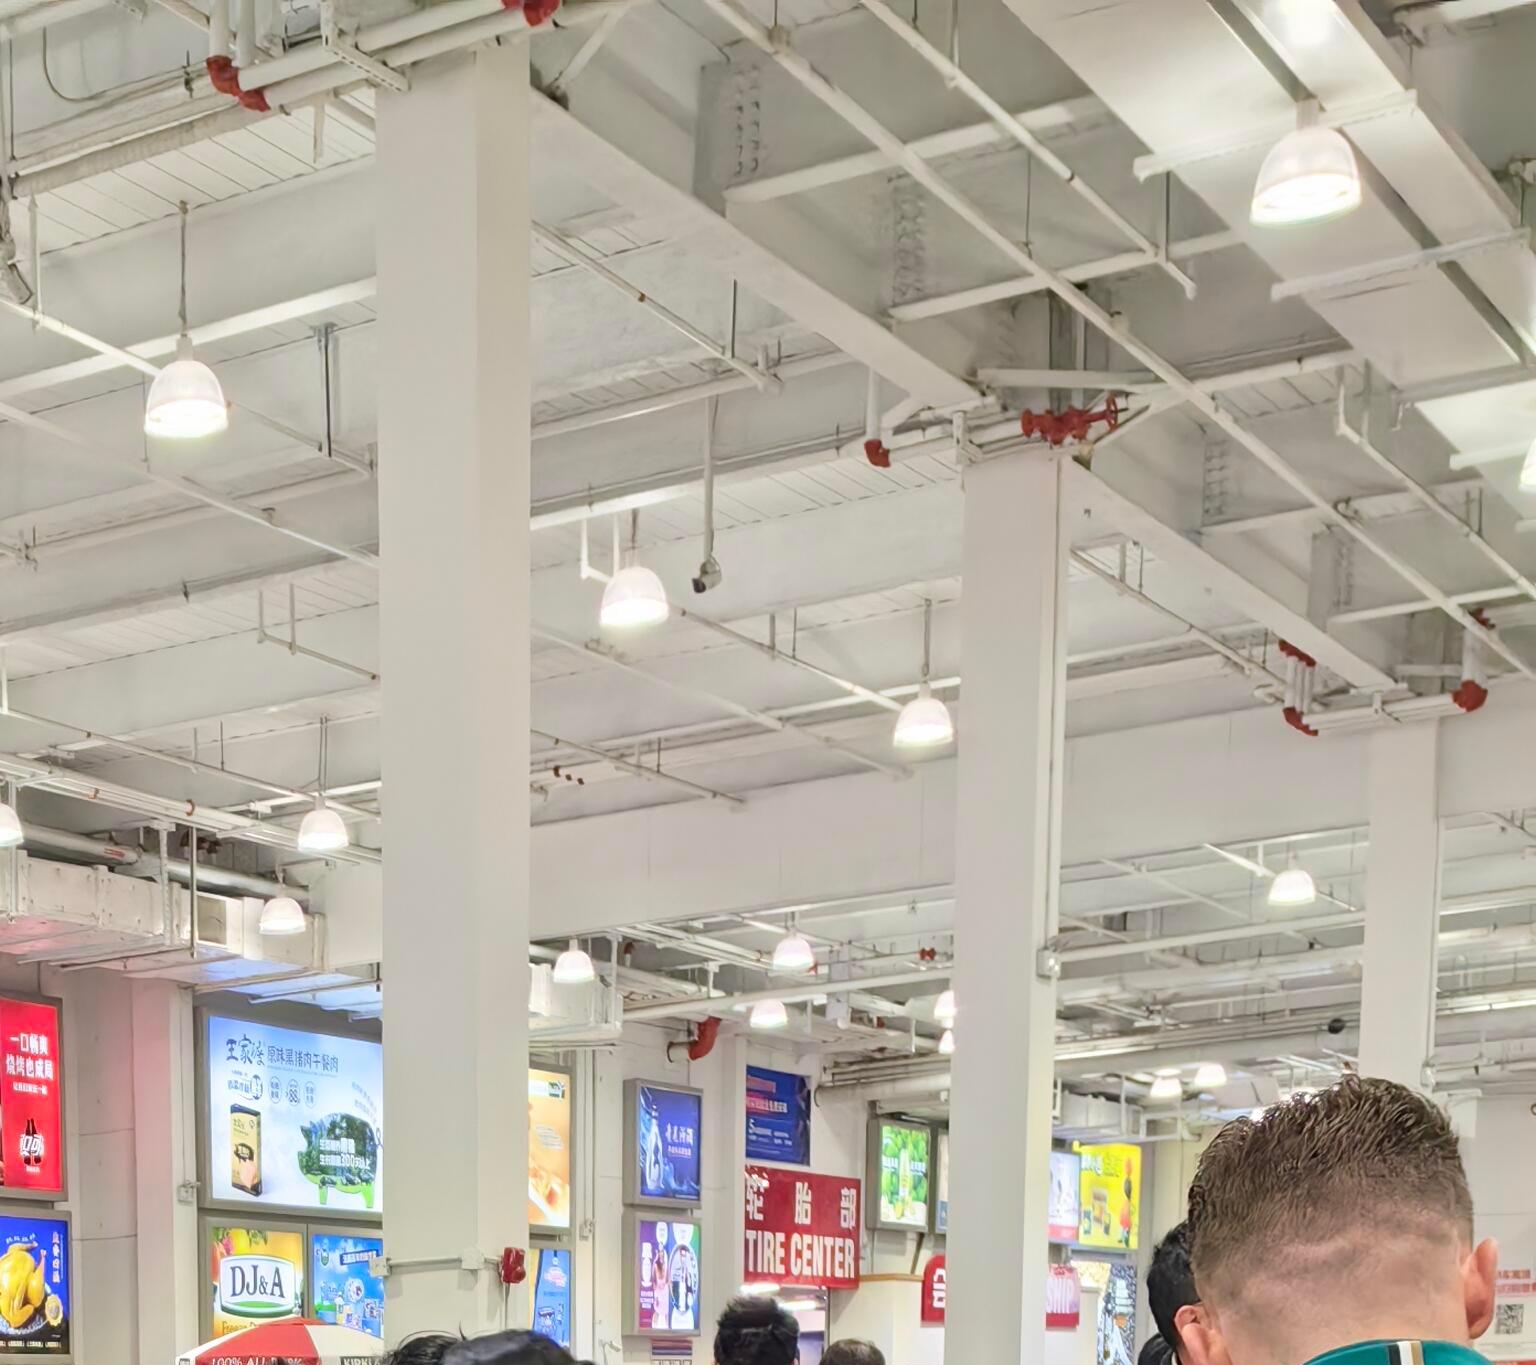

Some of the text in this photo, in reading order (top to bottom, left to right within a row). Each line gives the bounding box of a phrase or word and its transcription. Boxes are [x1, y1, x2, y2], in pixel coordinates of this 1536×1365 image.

[746, 1230, 856, 1279] TIRE CENTER
[230, 1265, 285, 1299] DJ&A
